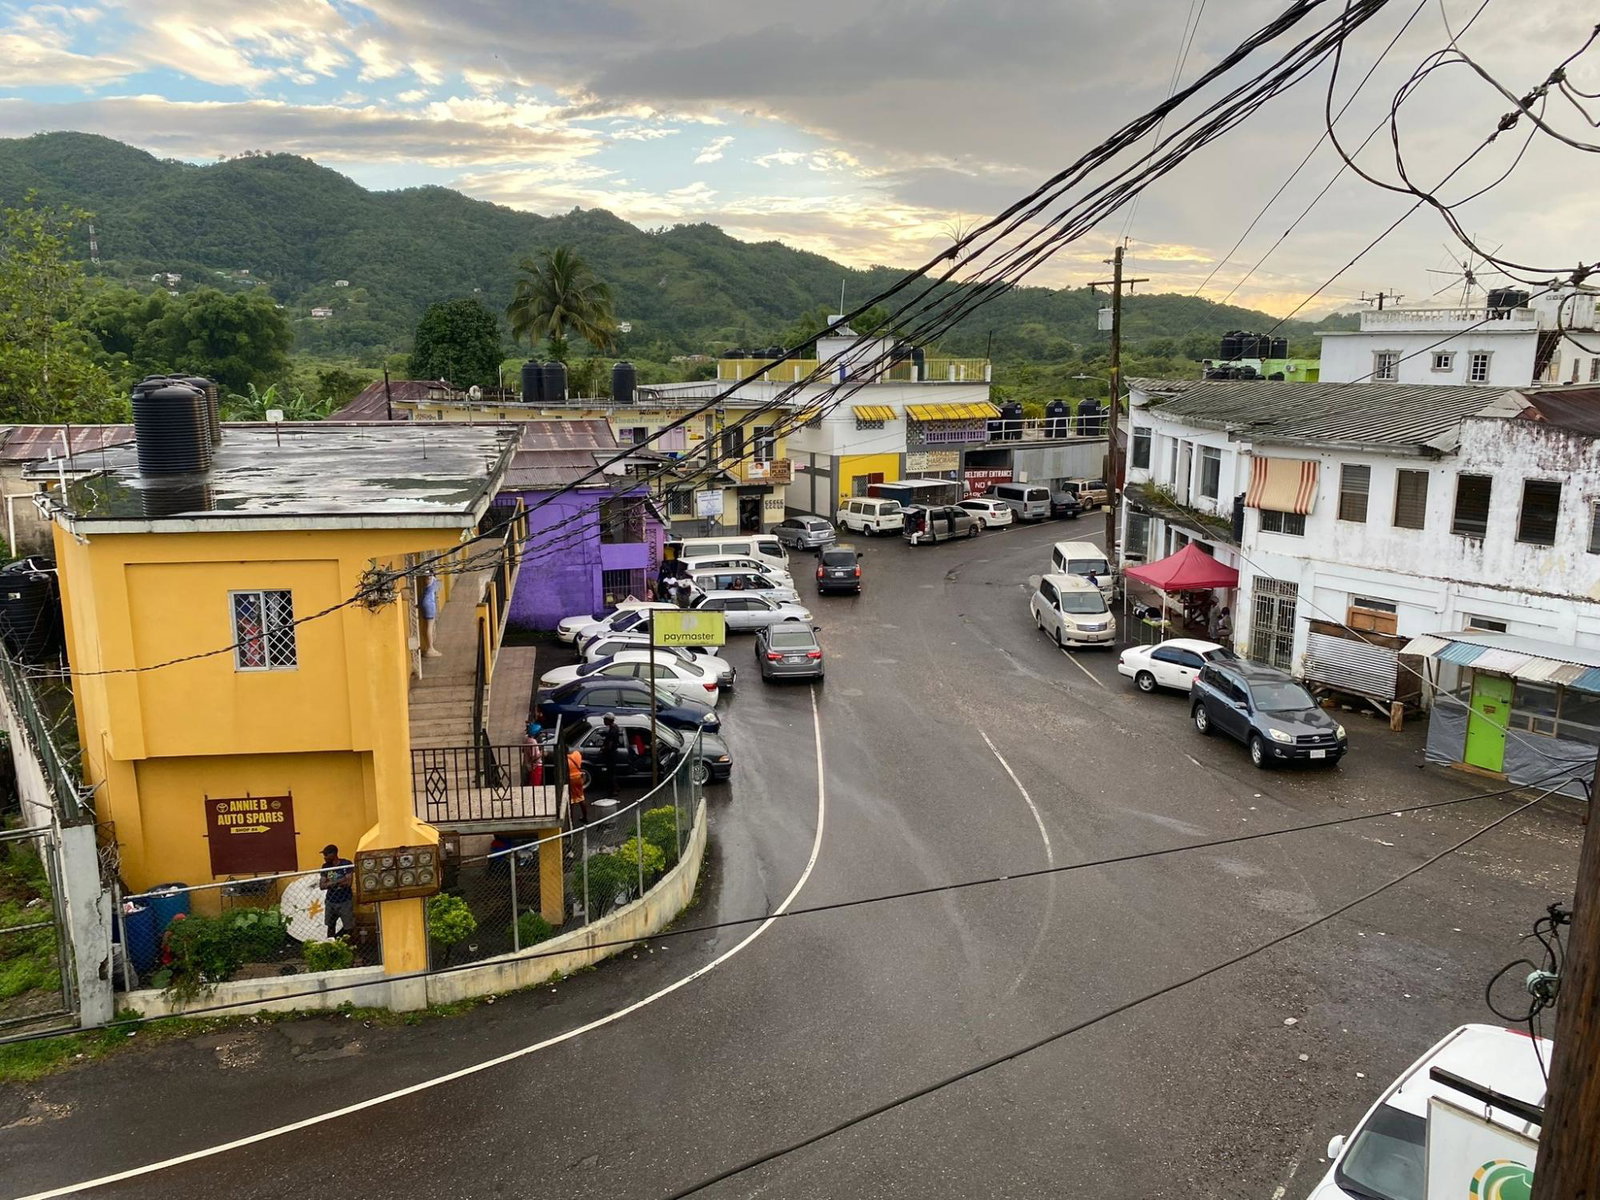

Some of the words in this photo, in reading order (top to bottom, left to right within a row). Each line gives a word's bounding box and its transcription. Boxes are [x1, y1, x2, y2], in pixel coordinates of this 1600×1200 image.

[663, 632, 715, 642] paymaster
[230, 800, 259, 812] ANNIE
[260, 799, 268, 810] B
[217, 813, 244, 825] AUTO
[246, 811, 284, 824] SPARES
